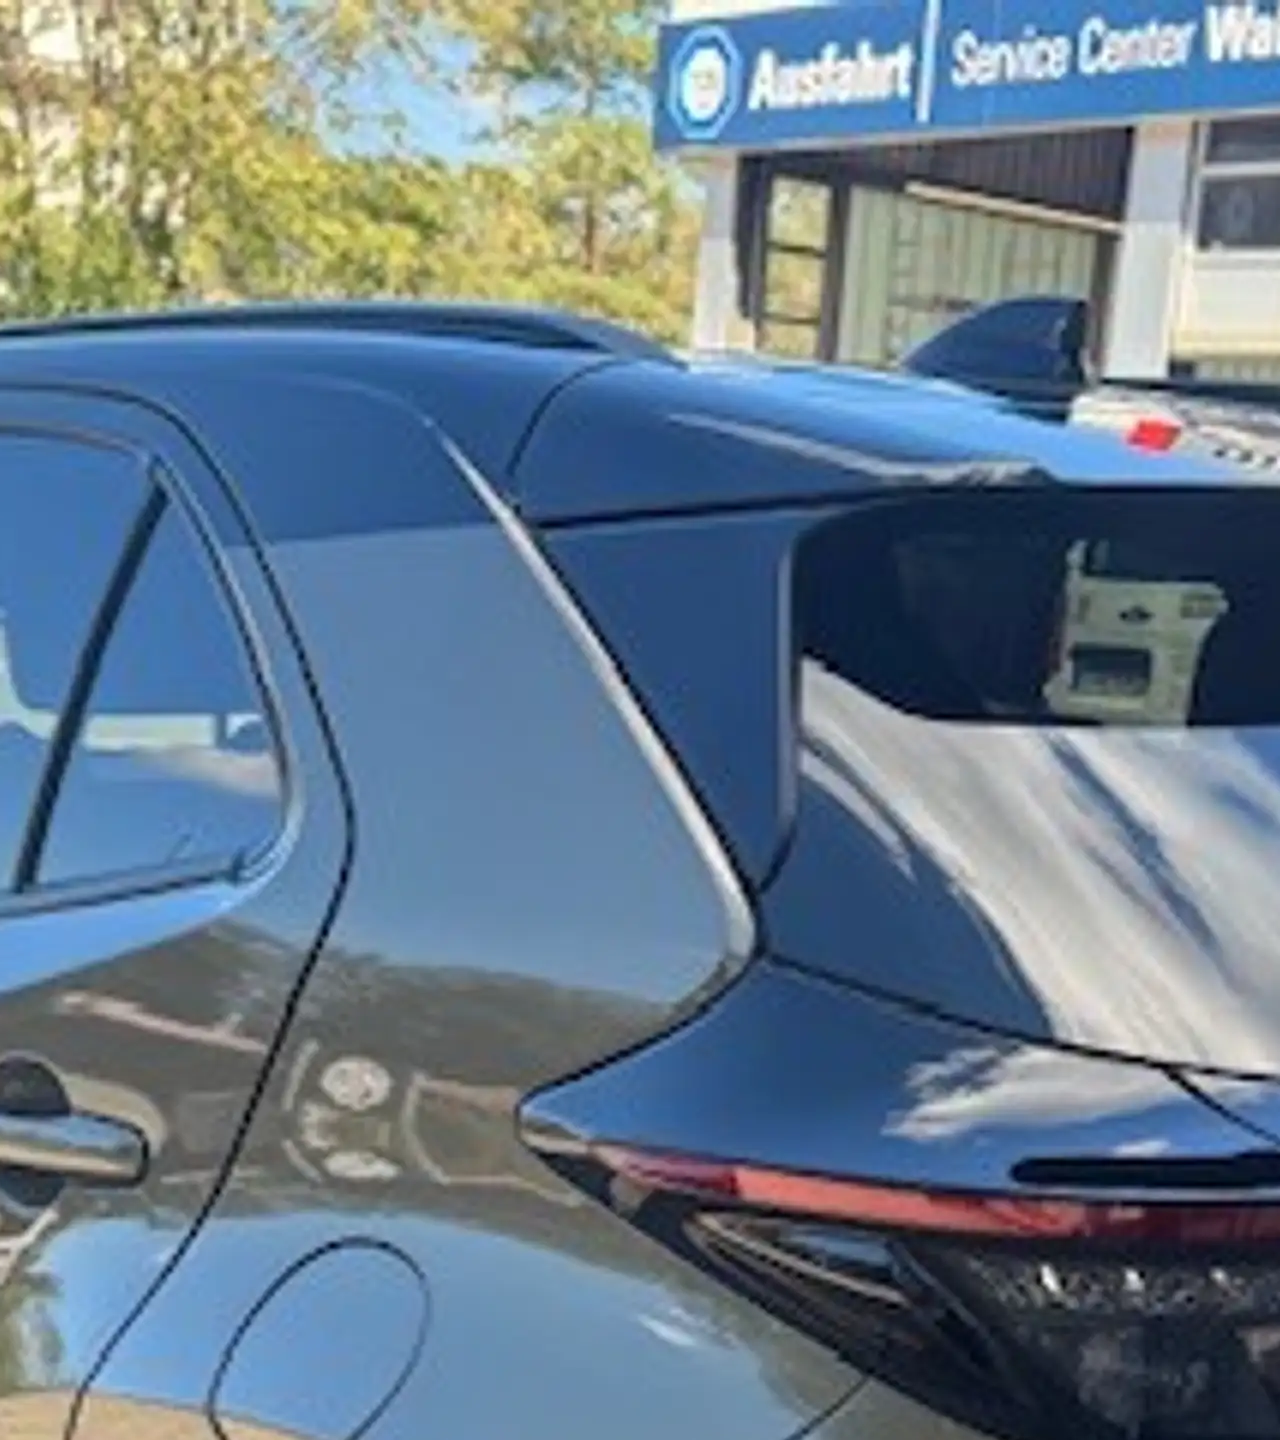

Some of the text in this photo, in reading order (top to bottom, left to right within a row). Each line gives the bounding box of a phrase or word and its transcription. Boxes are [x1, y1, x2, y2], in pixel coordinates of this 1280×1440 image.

[747, 39, 913, 111] Ausfahrt
[951, 22, 1070, 88] Service
[1077, 16, 1198, 76] Center
